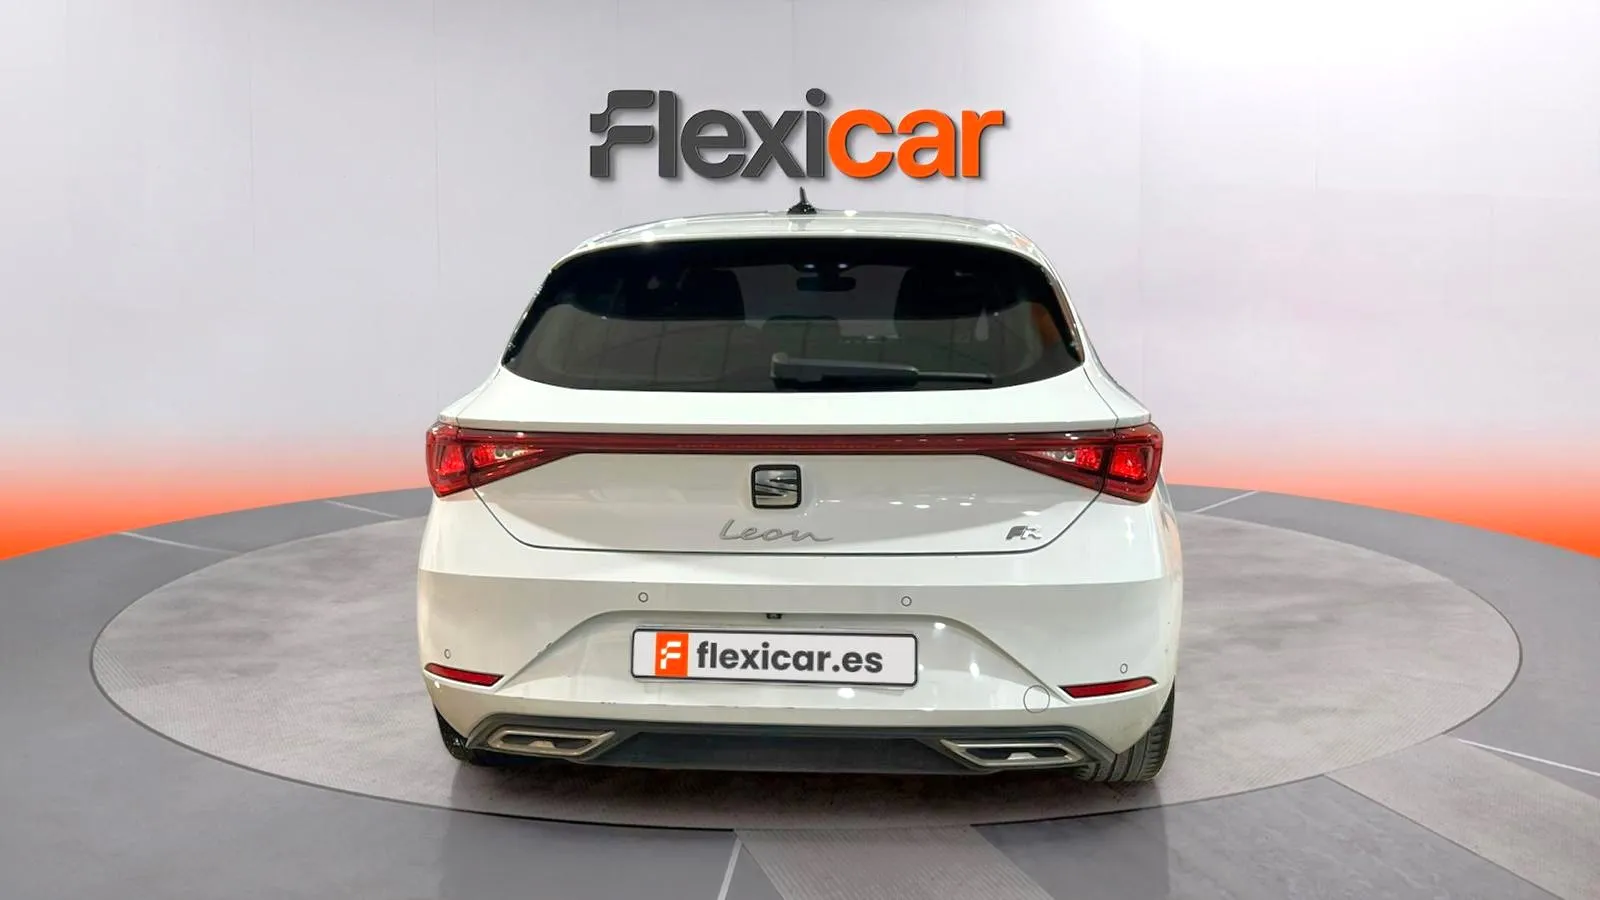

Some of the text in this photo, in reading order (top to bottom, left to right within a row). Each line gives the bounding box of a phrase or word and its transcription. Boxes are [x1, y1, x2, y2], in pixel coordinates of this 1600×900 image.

[590, 88, 1005, 178] Flexicar
[719, 519, 833, 542] Leon
[697, 641, 883, 673] flexicar.es
